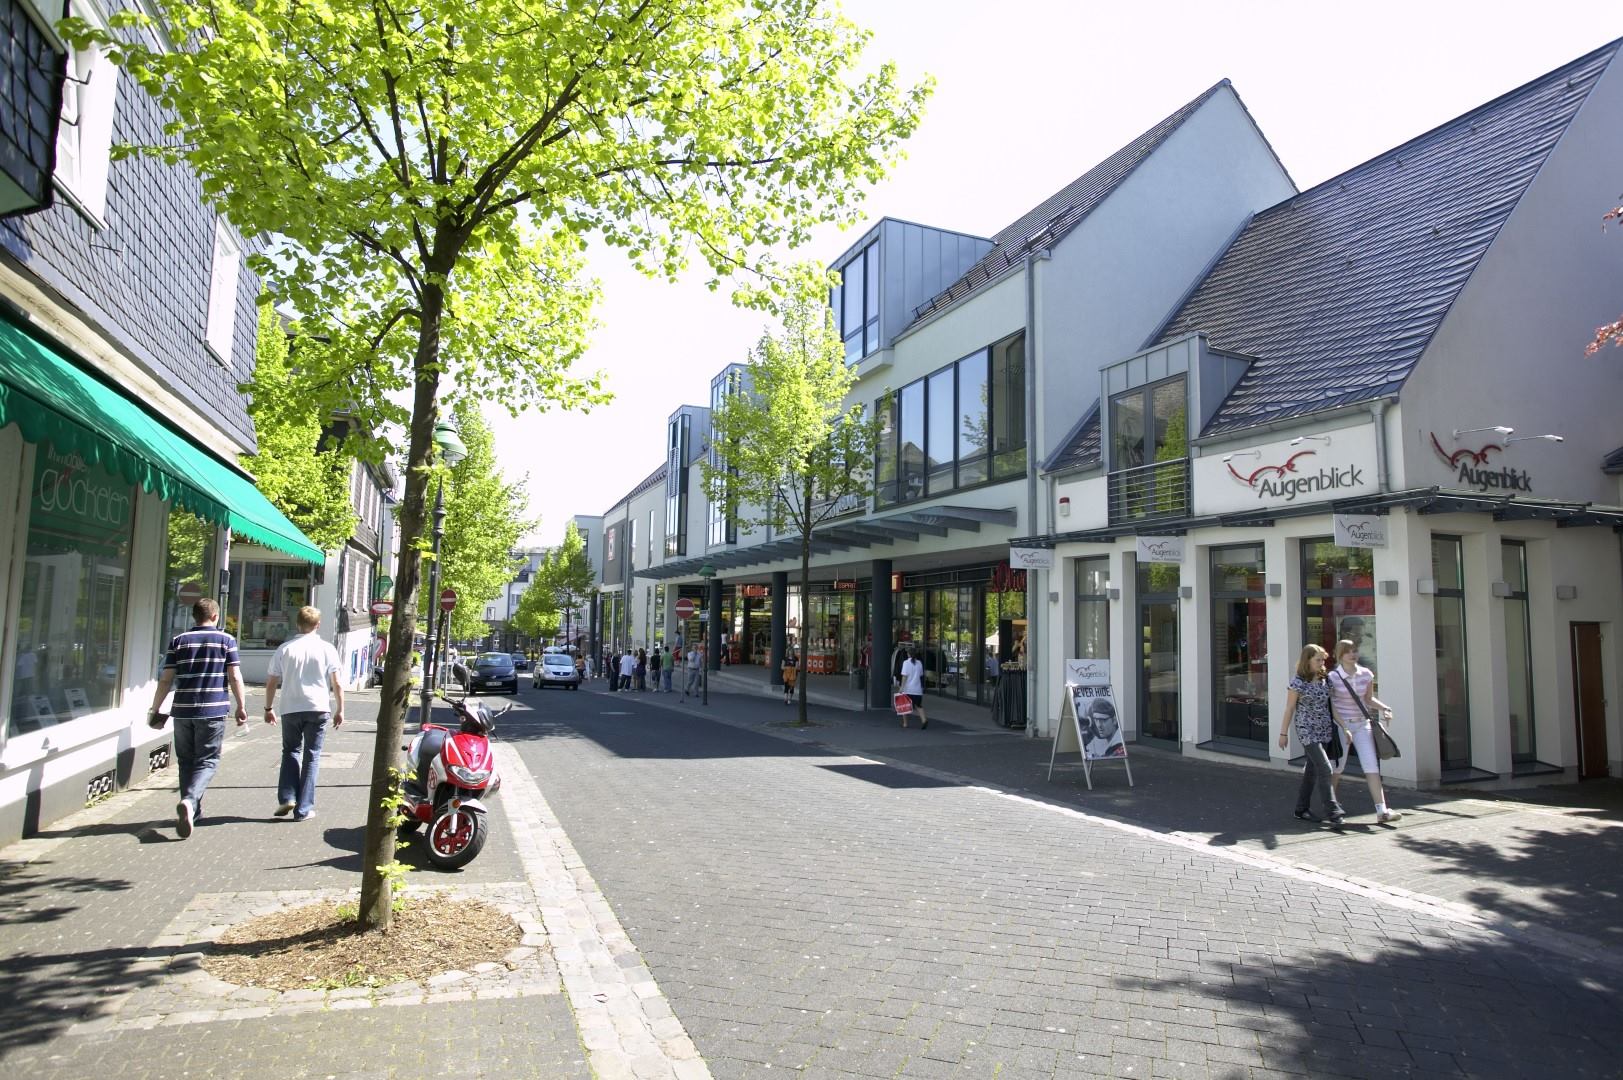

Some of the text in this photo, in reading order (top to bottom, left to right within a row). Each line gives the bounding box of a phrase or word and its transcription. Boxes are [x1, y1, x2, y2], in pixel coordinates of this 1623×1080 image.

[1259, 464, 1364, 501] Augenblick
[1458, 462, 1533, 493] Augenblick
[1350, 529, 1385, 542] Augenblick
[1072, 687, 1111, 698] NEVER HIDE
